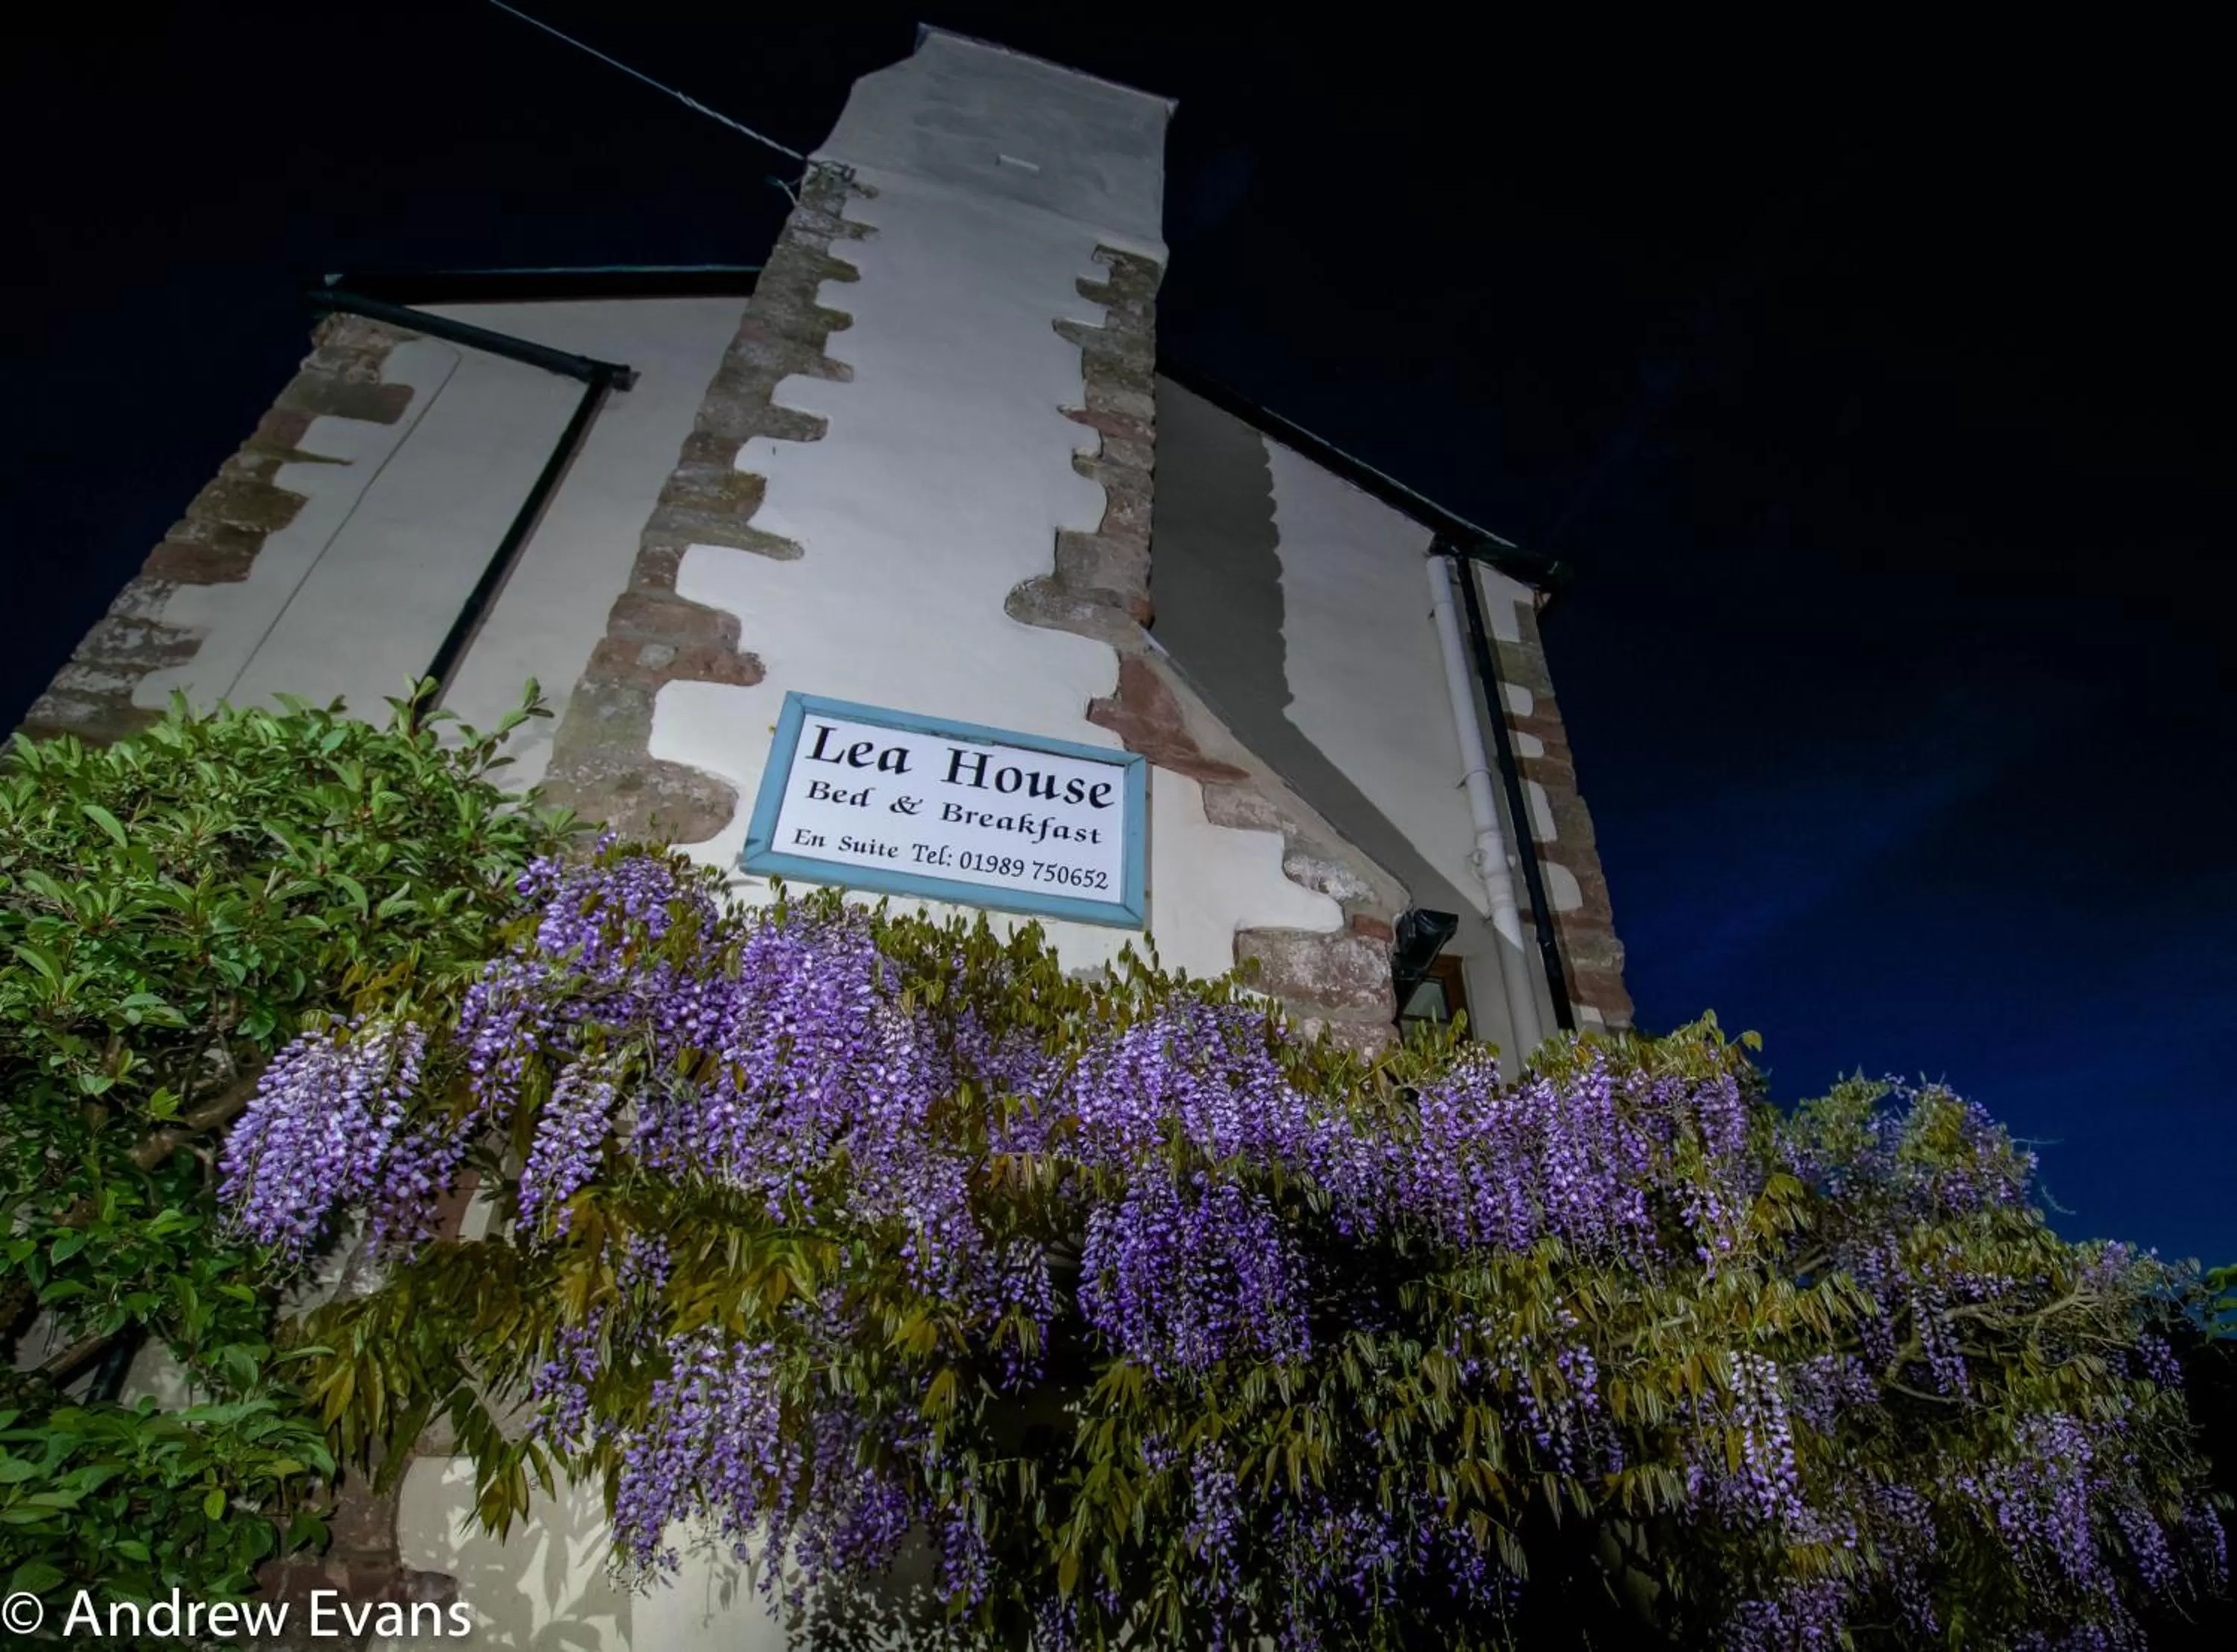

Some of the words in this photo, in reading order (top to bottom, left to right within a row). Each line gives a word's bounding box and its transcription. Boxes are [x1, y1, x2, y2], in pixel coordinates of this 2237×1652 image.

[805, 725, 912, 775] Lea
[940, 748, 1115, 809] House
[805, 781, 875, 807] Bed
[889, 795, 924, 816] &
[940, 803, 1104, 845] Breakfast
[793, 829, 825, 848] En
[837, 835, 899, 858] Suite
[912, 843, 952, 867] Tel:
[960, 851, 1025, 878] 01989
[1033, 860, 1109, 890] 750652
